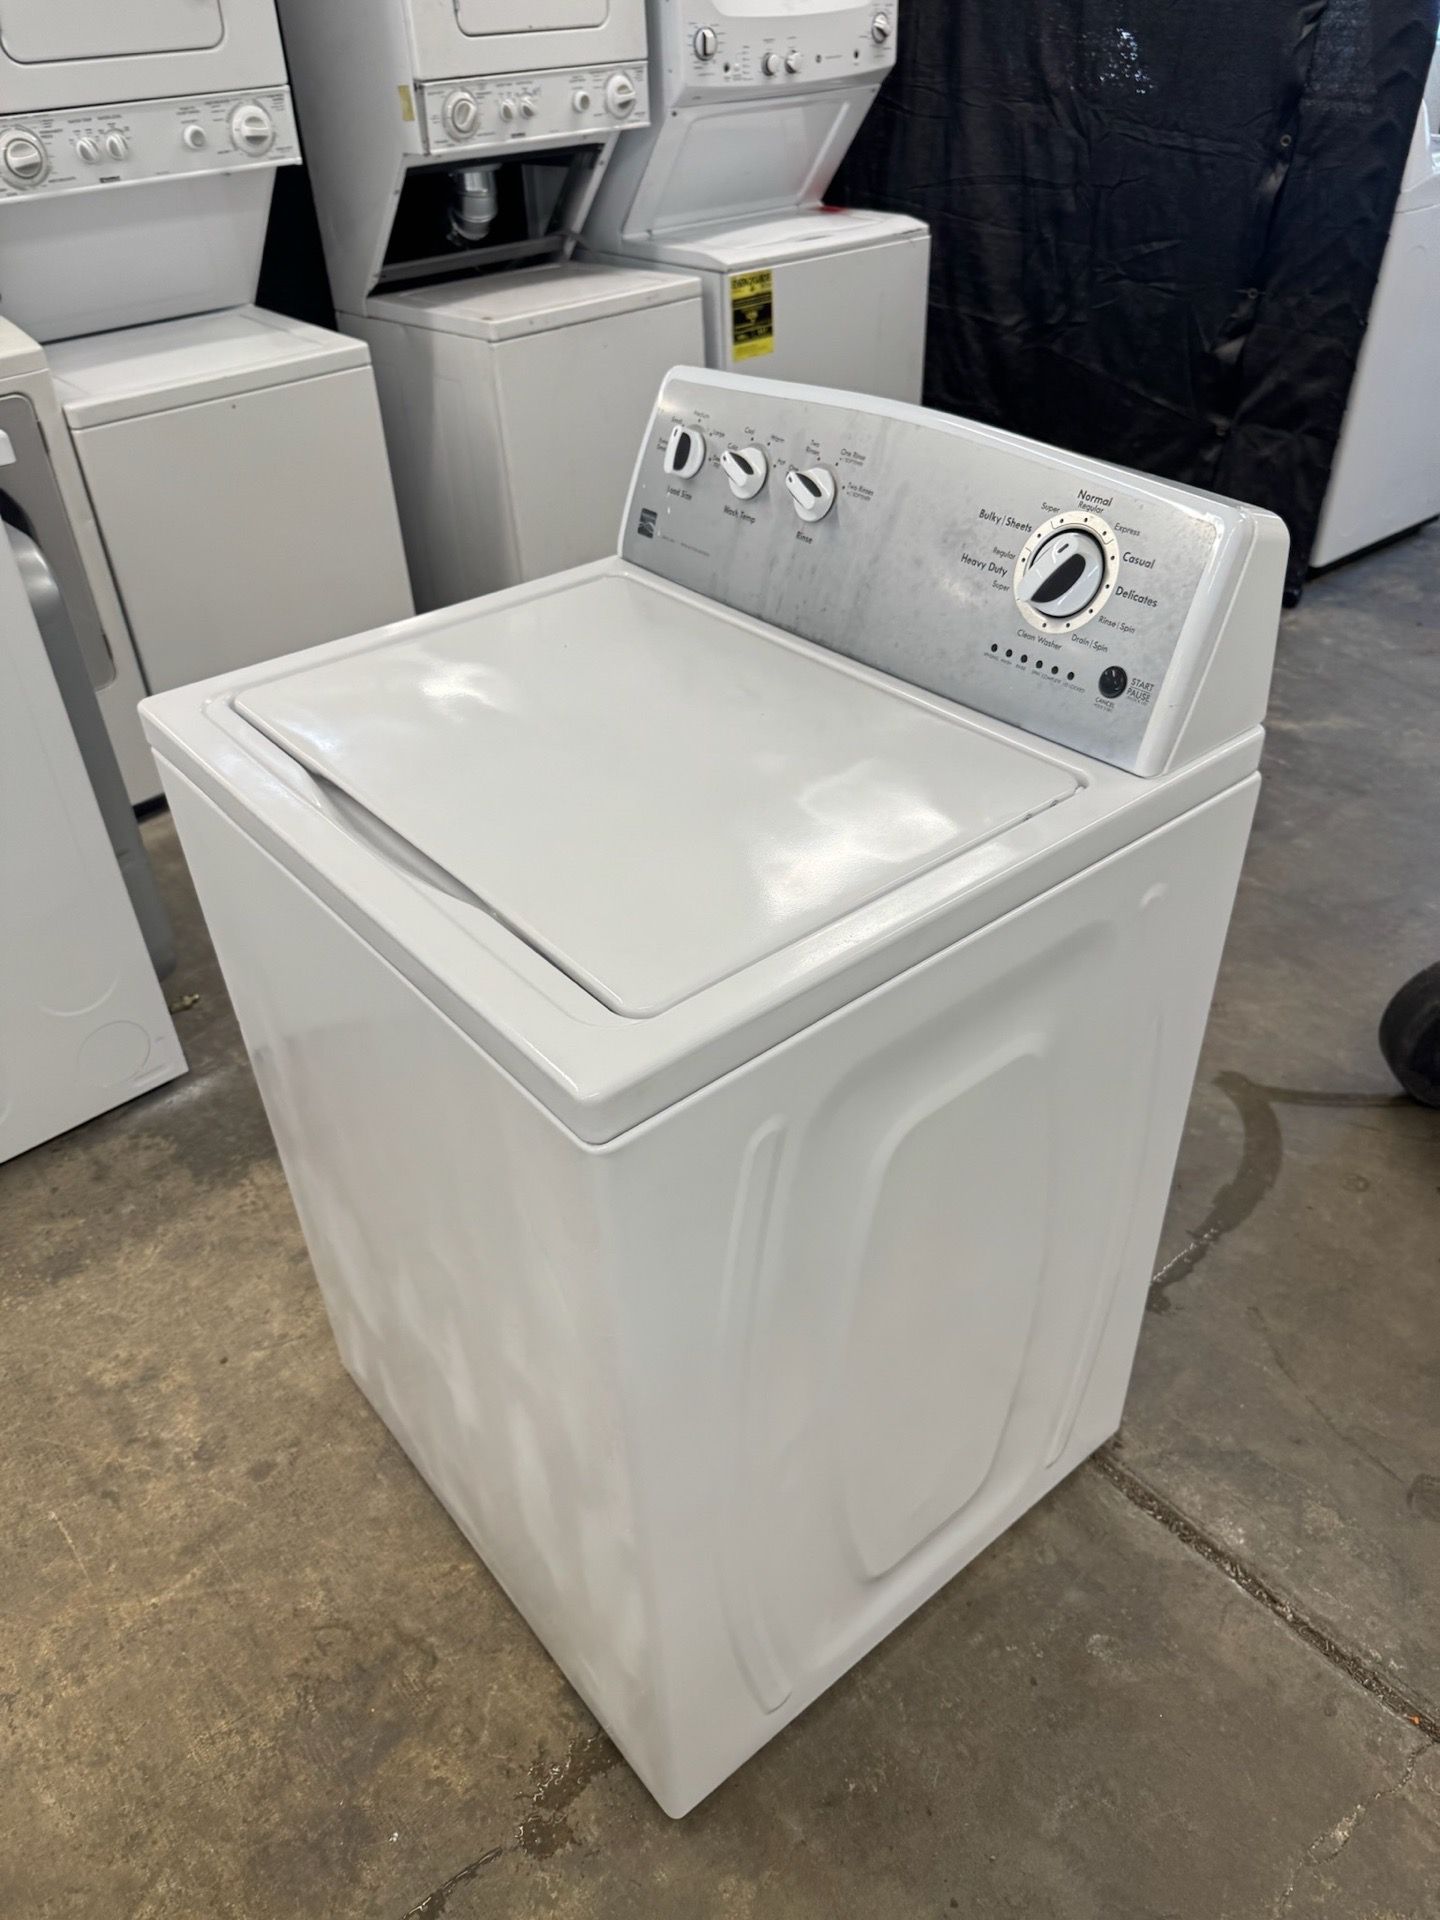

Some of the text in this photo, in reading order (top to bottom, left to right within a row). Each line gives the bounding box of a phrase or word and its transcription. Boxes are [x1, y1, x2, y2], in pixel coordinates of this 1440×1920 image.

[1077, 488, 1113, 507] Normal
[1041, 502, 1060, 513] Super
[1078, 501, 1104, 514] Regular
[1114, 522, 1141, 537] Express
[993, 546, 1016, 560] Regular
[1122, 551, 1156, 569] Casual
[961, 552, 1008, 577] Heavy Duty
[992, 579, 1010, 592] Super
[1115, 585, 1159, 608] Delicates
[1016, 629, 1063, 651] Clean Washer
[1131, 678, 1154, 692] START
[1127, 687, 1151, 703] PAUSE
